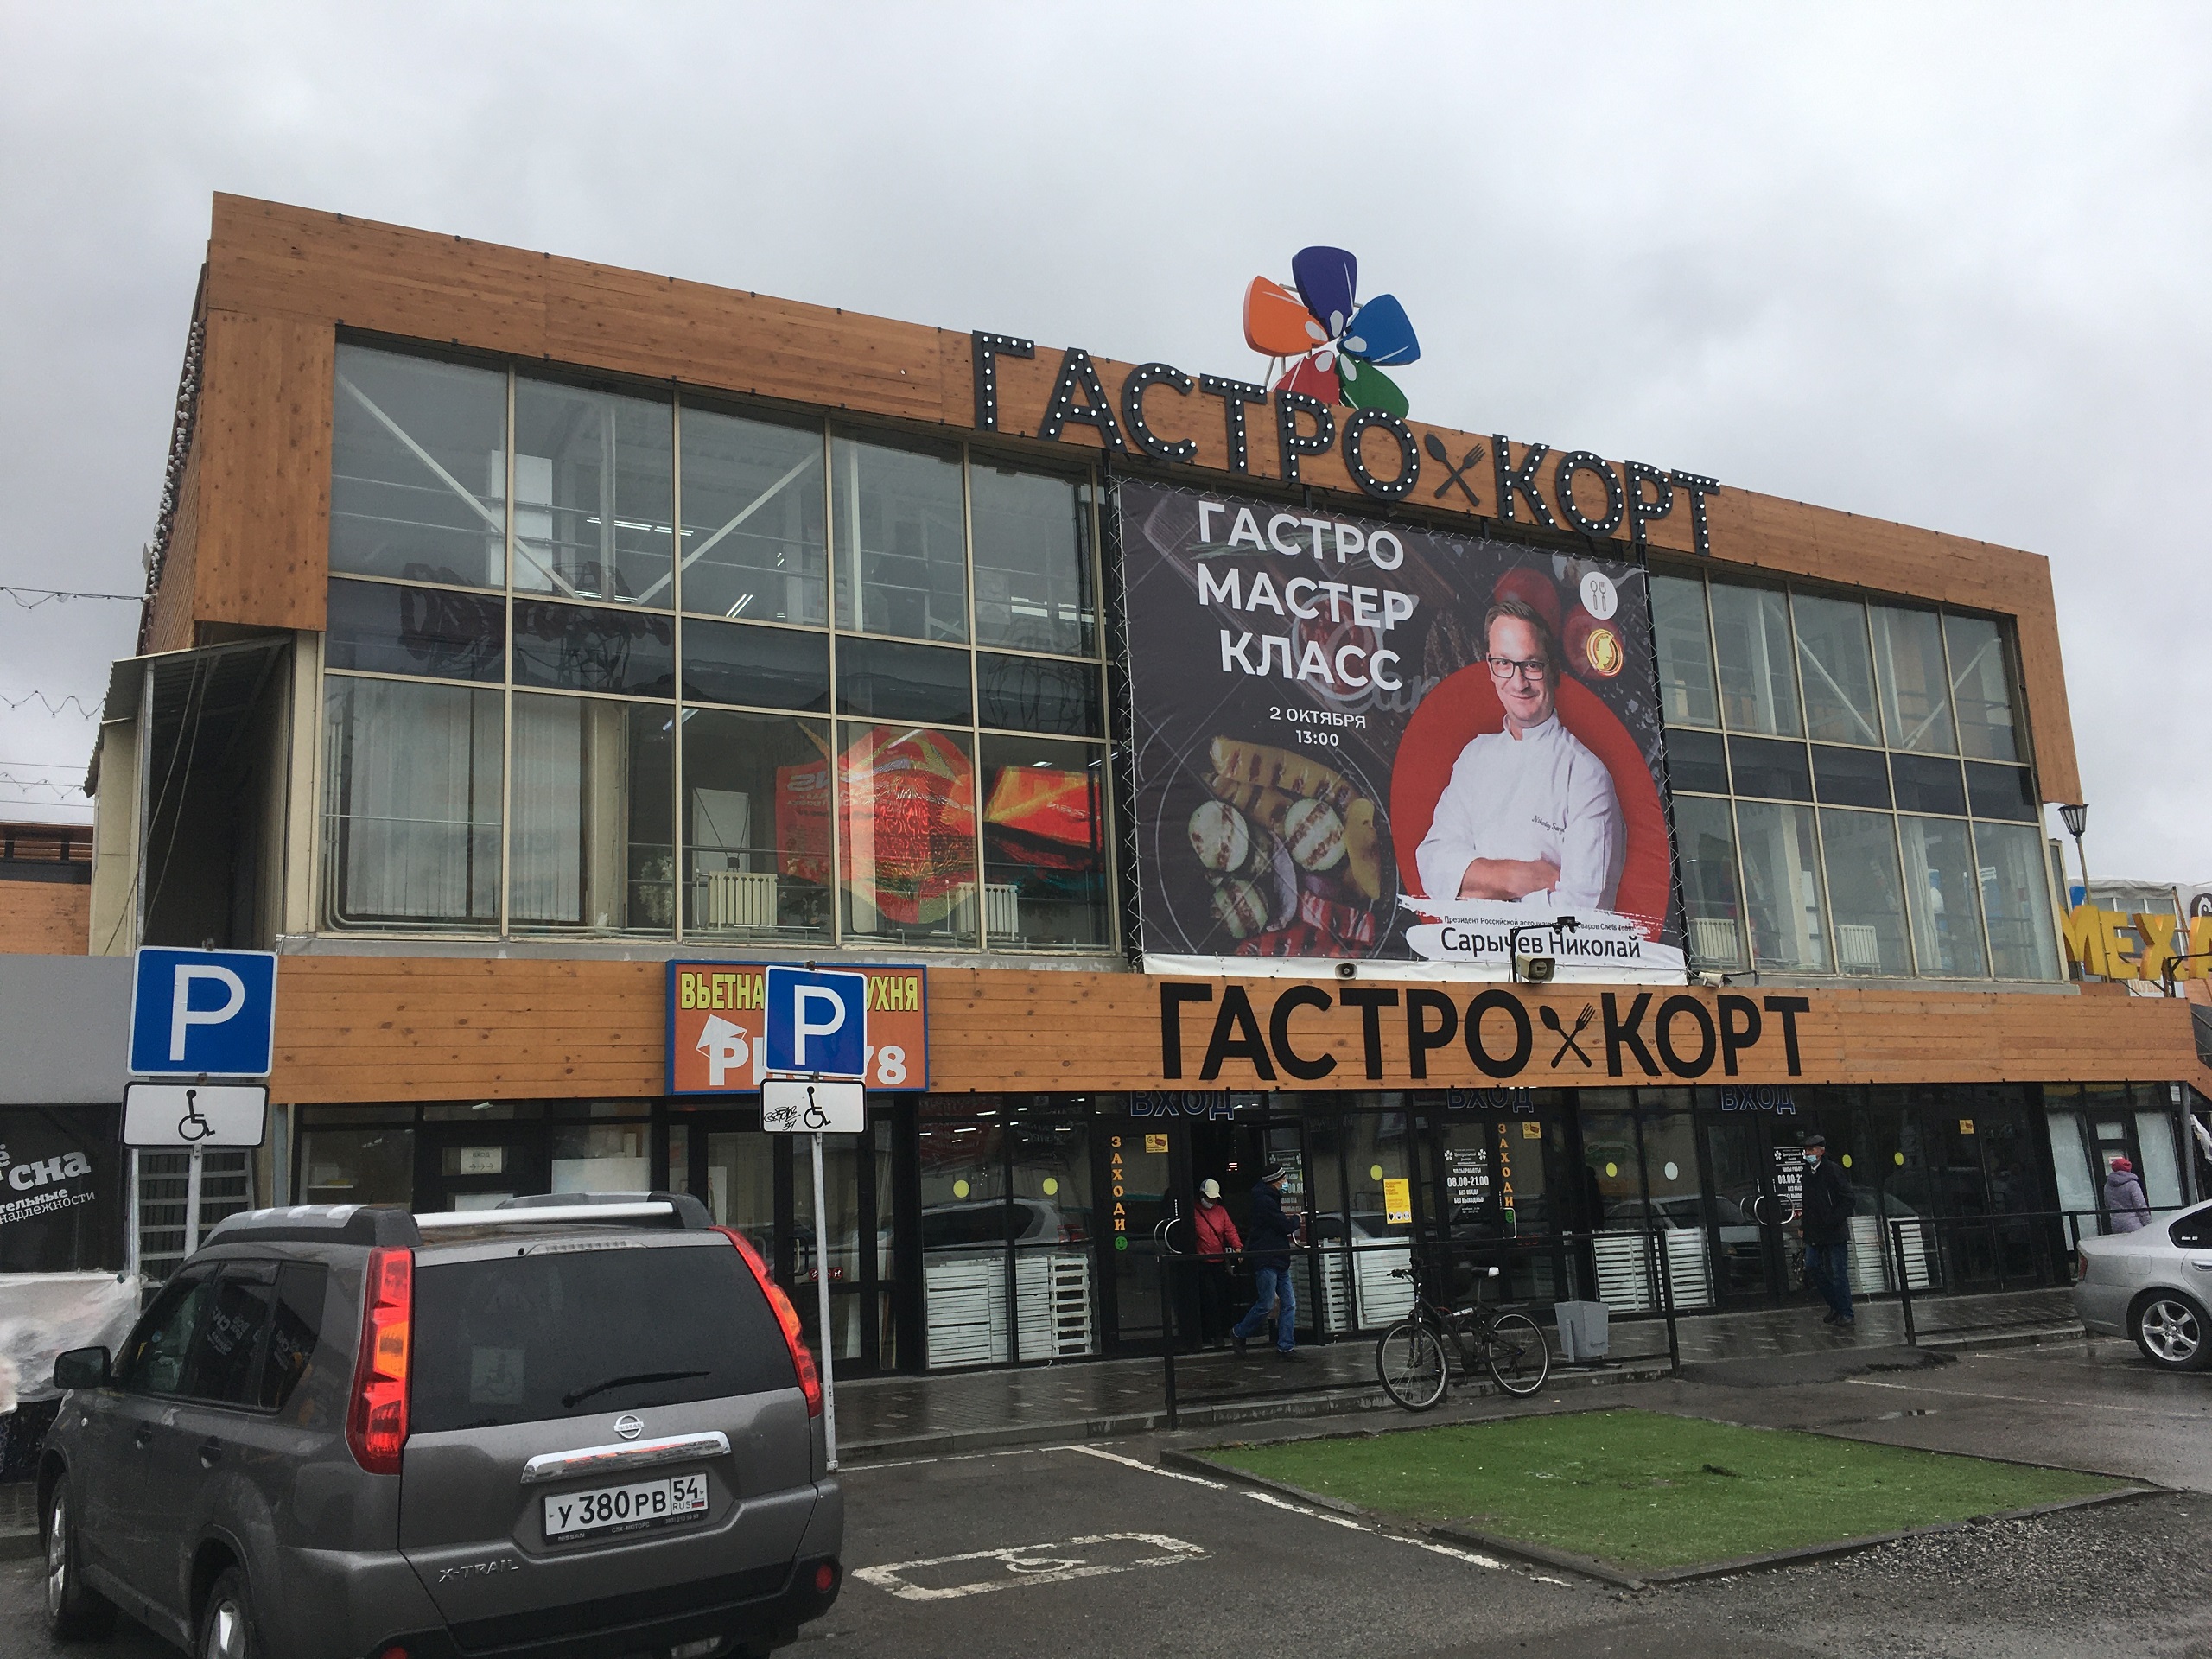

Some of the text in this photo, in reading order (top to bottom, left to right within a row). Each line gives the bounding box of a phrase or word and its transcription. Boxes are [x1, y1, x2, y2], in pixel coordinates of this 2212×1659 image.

[971, 329, 1721, 556] ГАСТРО КОРТ
[1198, 500, 1404, 571] ГАСТРО
[1197, 563, 1414, 631] МАСТЕР
[1219, 629, 1404, 691] КЛАСС
[1269, 706, 1367, 729] 2 ОКТЯБРЯ
[1296, 730, 1339, 747] 13:00
[1444, 916, 1479, 925] Президент
[1480, 917, 1518, 926] Российской
[1441, 926, 1641, 958] Сарычев Николай
[681, 972, 918, 1011] ВЬЕТНА УХНЯ
[169, 963, 245, 1061] P
[794, 984, 846, 1065] P
[1160, 982, 1810, 1082] ГАСТРО КОРТ
[1130, 1091, 1234, 1121] ВХОД
[1446, 1088, 1535, 1114] ВХОД
[1721, 1084, 1796, 1115] ВХОД
[1446, 1175, 1490, 1188] 08.00-21.00
[672, 1501, 691, 1510] RUS
[673, 1478, 699, 1502] 54
